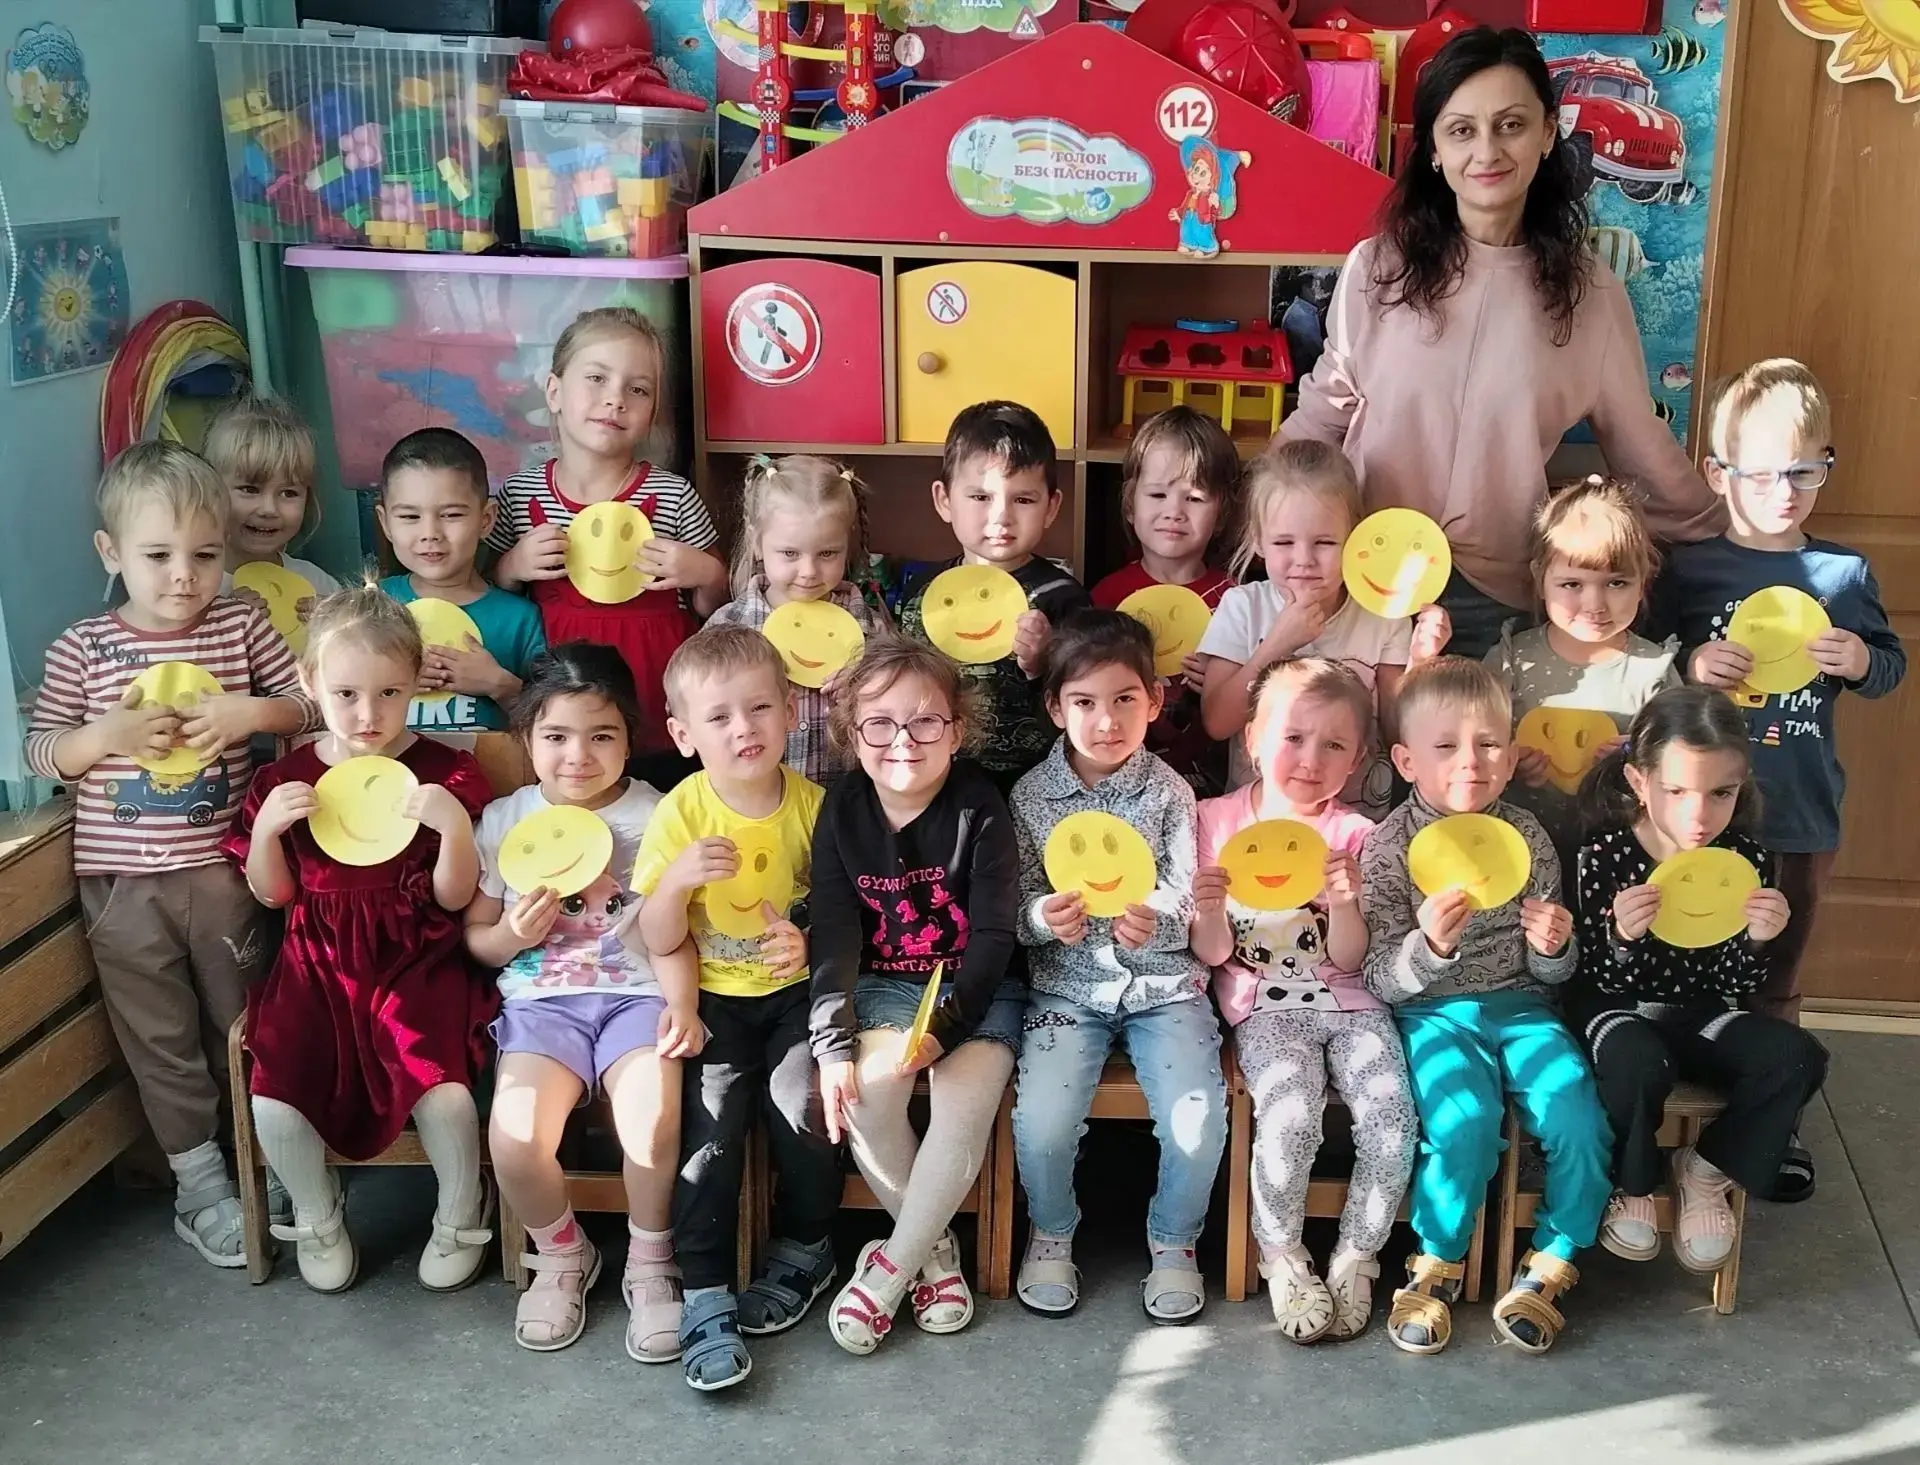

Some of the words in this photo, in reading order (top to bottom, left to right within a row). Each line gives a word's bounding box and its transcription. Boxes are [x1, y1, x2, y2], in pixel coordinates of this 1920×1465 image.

[1164, 101, 1208, 128] 112
[404, 694, 477, 726] IKE
[1779, 688, 1823, 714] PLAY
